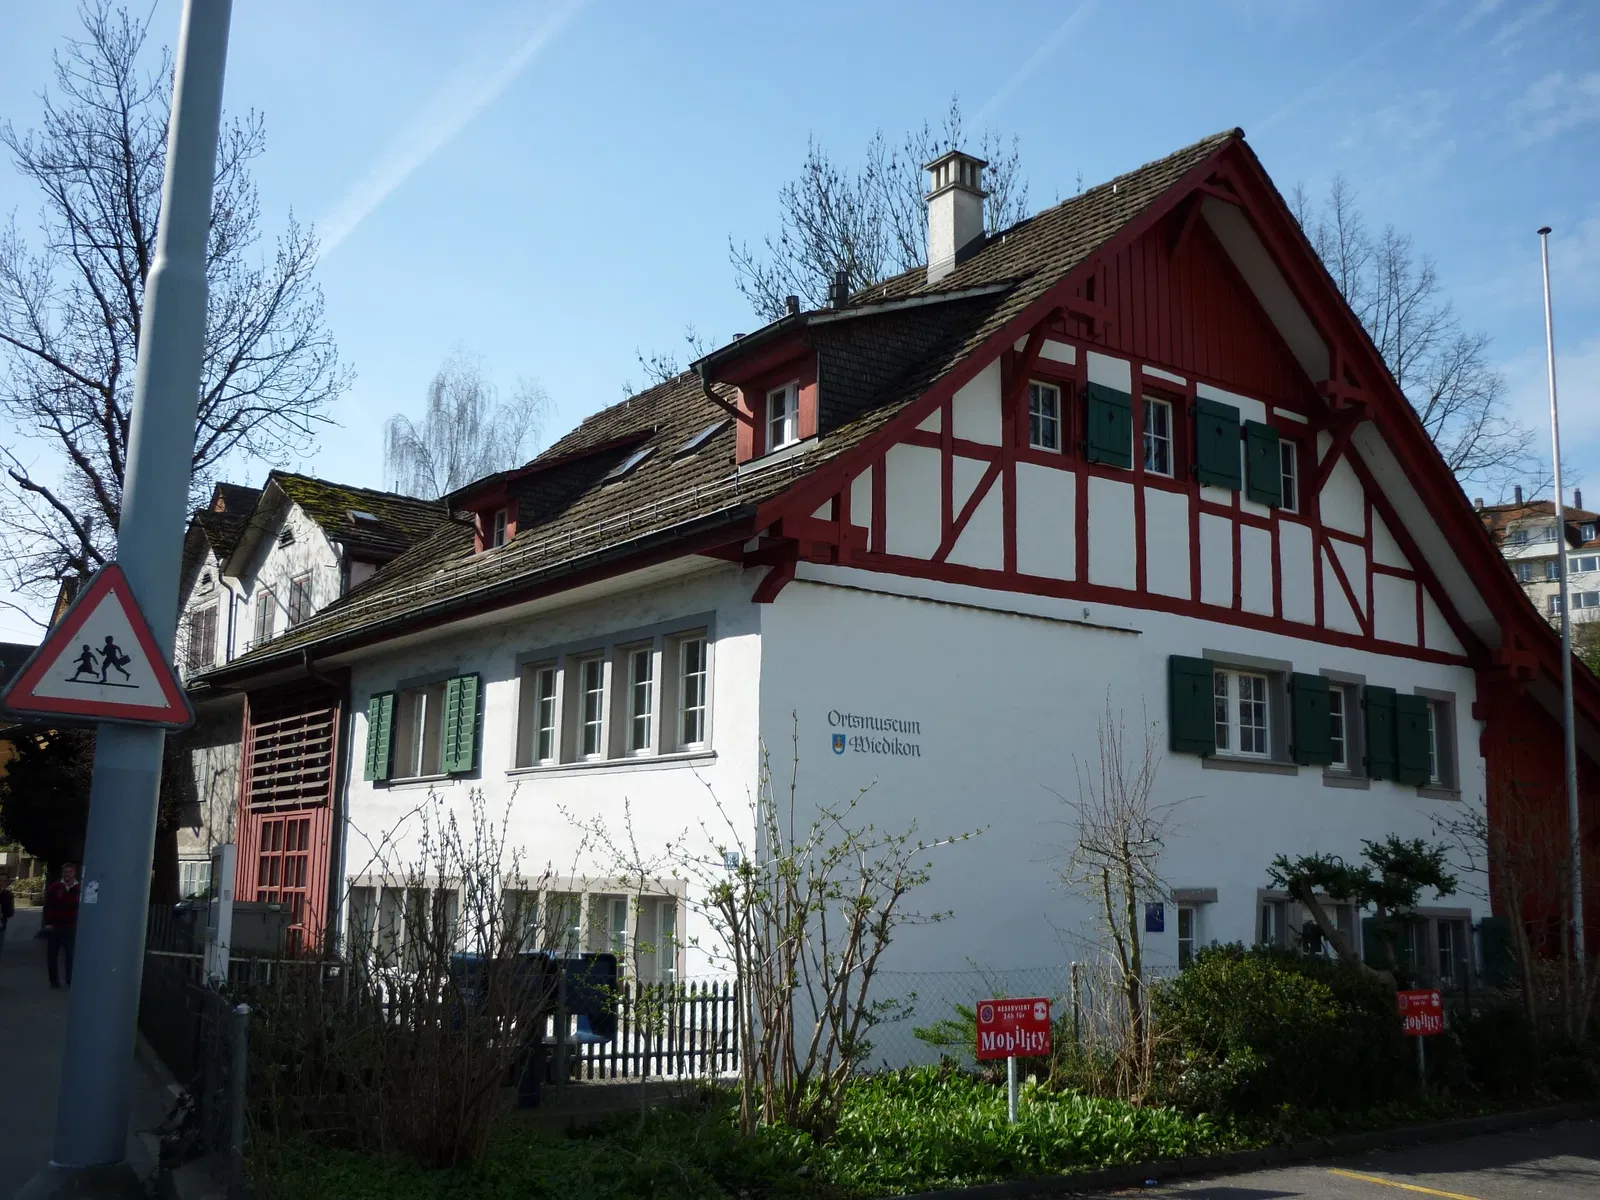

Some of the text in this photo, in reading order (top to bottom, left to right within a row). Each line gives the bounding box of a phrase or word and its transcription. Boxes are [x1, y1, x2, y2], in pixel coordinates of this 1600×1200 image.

[828, 709, 921, 735] Ortsmuseum
[848, 735, 921, 757] Wiedikon
[981, 1025, 1046, 1051] Mobility
